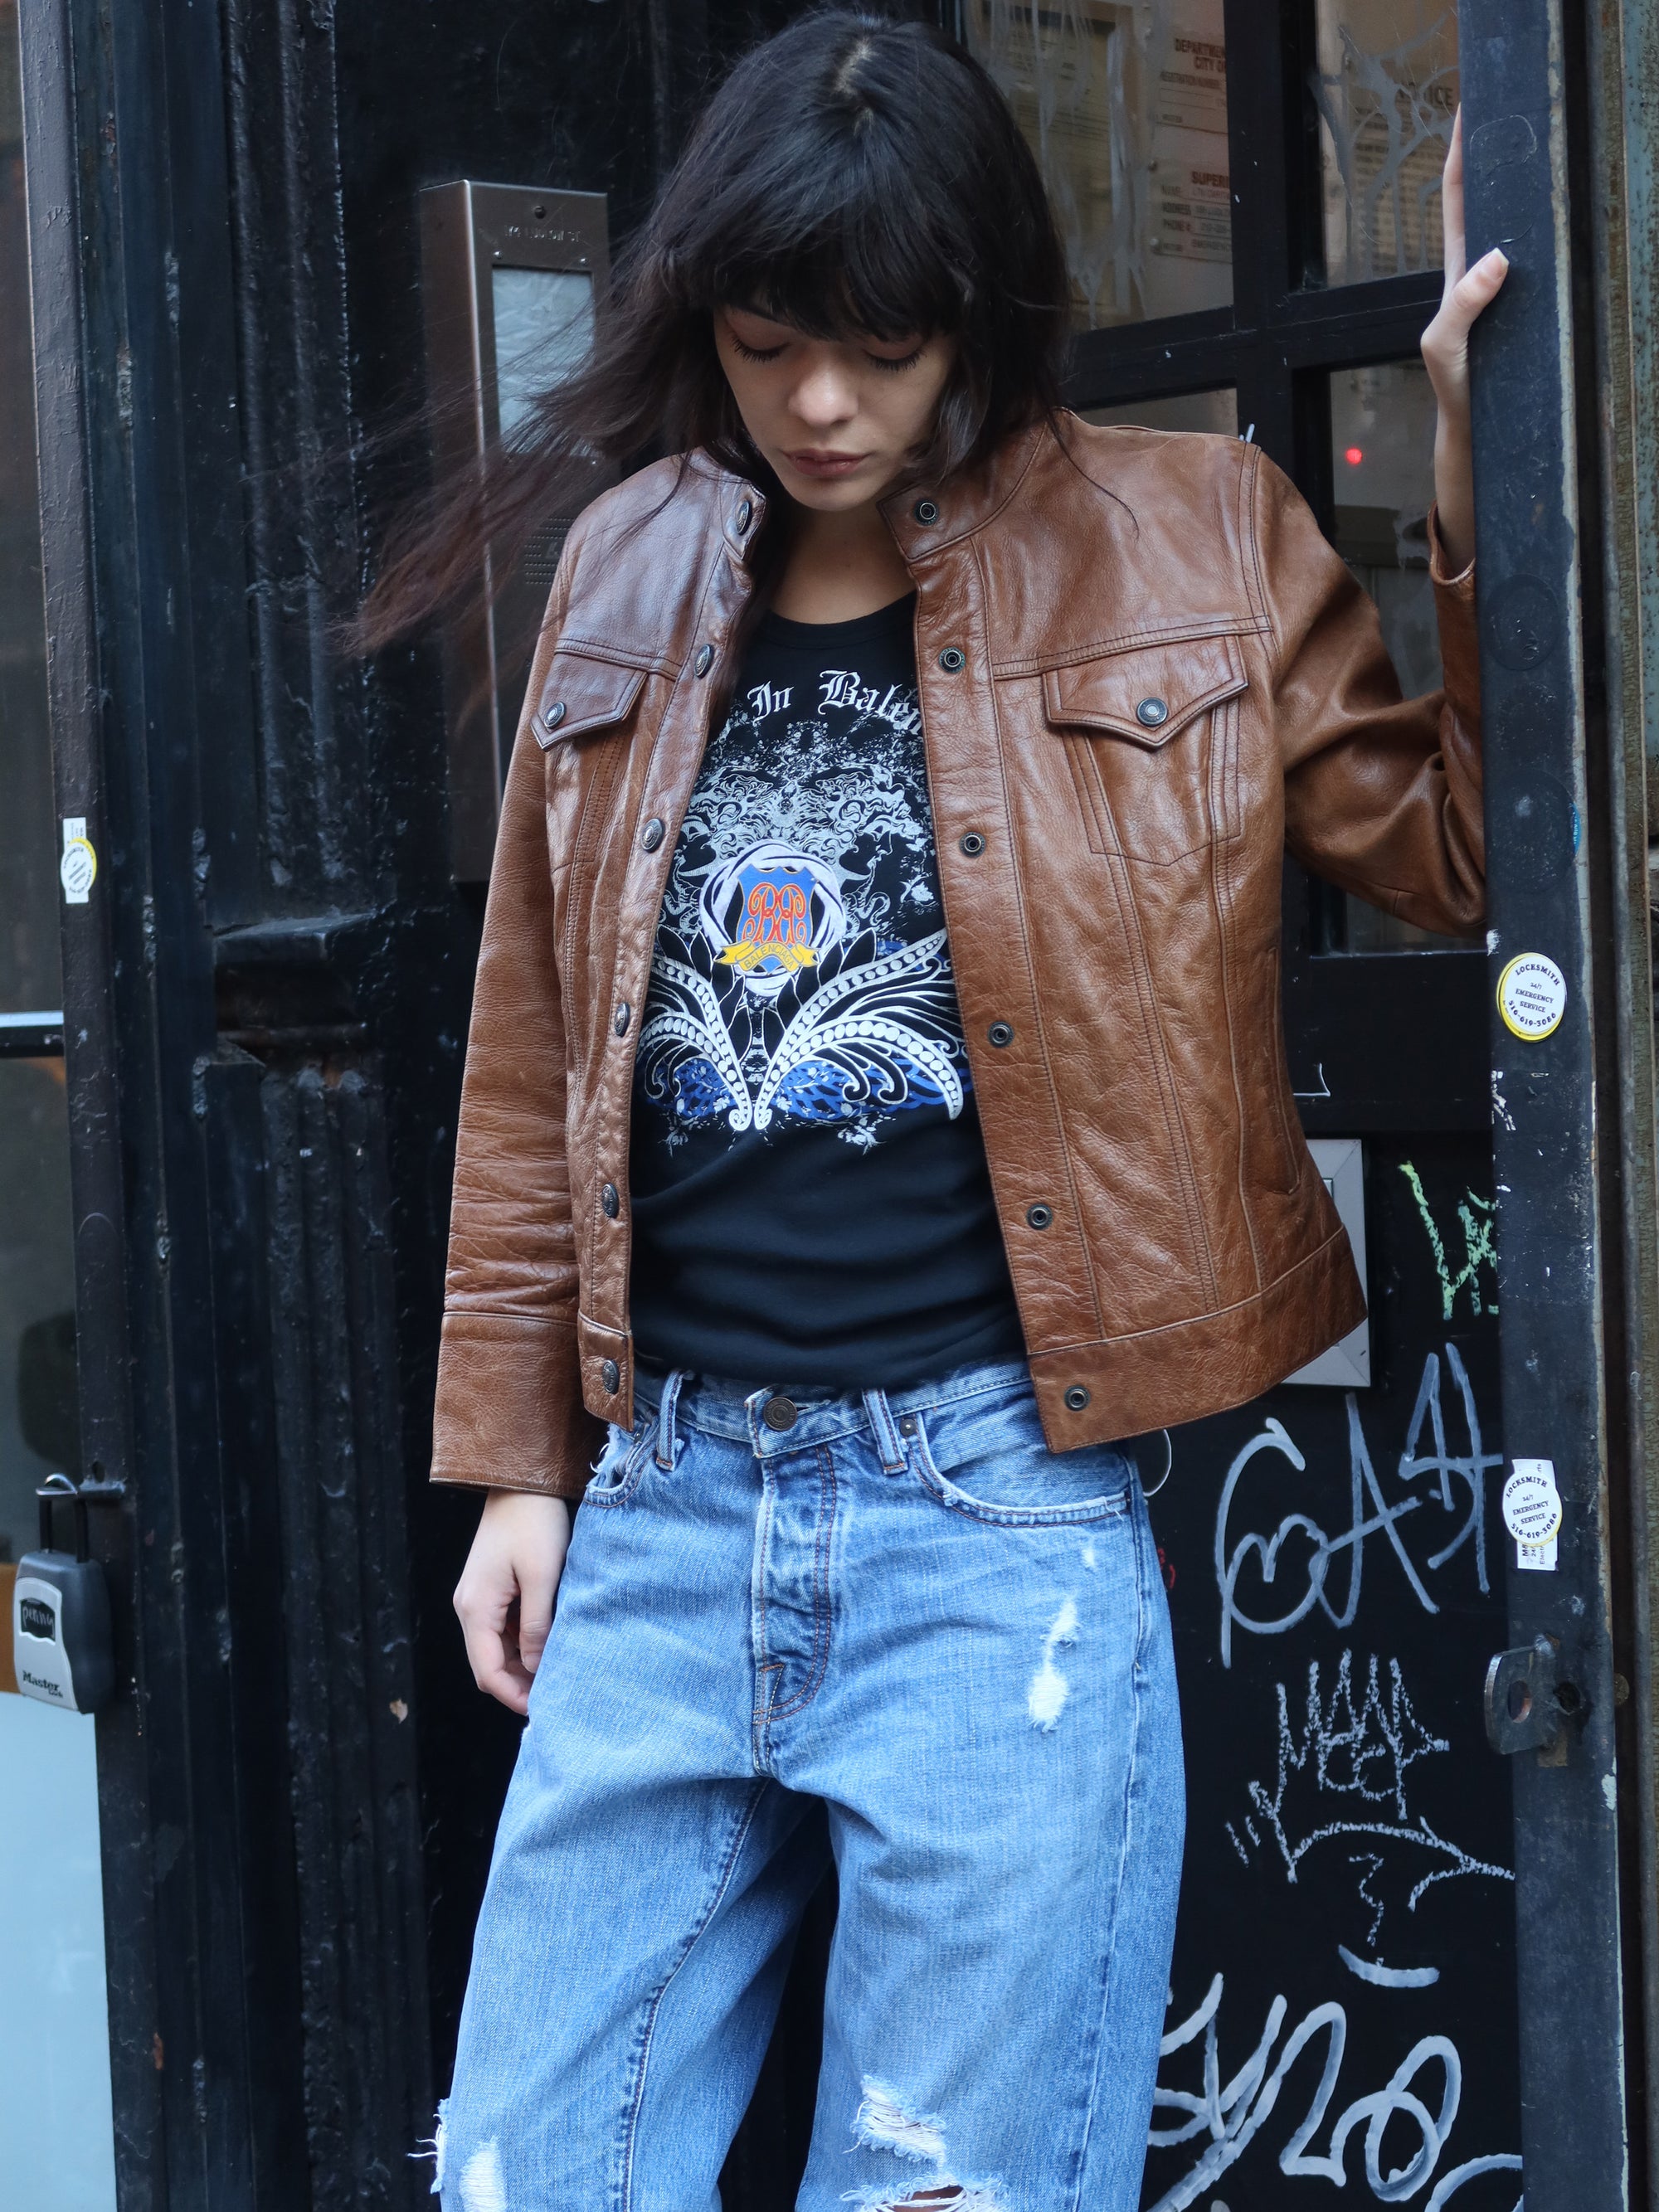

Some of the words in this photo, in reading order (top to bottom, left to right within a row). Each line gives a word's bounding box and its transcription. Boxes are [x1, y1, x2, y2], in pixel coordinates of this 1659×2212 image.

[747, 680, 795, 724] In
[744, 944, 795, 969] BALENCIAGA
[1515, 964, 1560, 986] LOCKSMITH
[1515, 989, 1554, 1004] EMERGENCY
[1520, 1000, 1546, 1013] SERVICE
[1506, 1476, 1547, 1498] LOCKSMITH
[1512, 1500, 1550, 1515] EMERGENCY
[1520, 1512, 1546, 1524] SERVICE
[22, 1670, 60, 1690] Master
